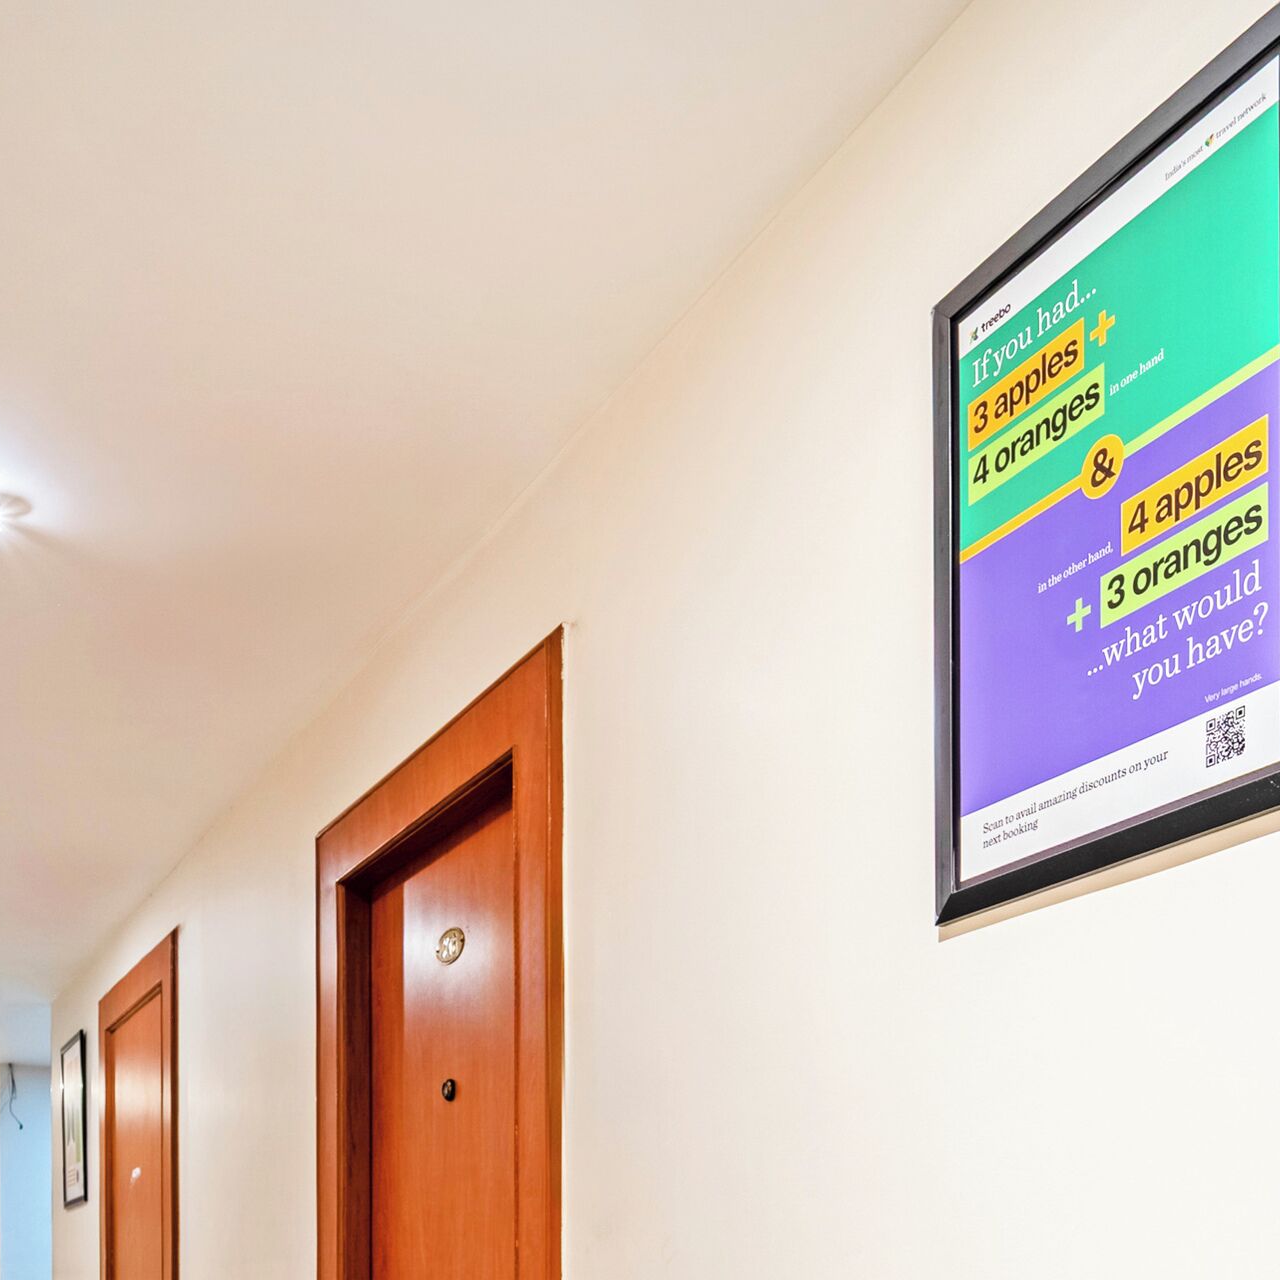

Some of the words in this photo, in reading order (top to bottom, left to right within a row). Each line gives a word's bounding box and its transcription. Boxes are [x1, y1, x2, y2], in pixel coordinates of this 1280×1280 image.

[972, 348, 993, 388] If
[992, 326, 1033, 377] you
[1036, 279, 1097, 338] had...
[981, 303, 1012, 333] treebo
[973, 400, 988, 434] 3
[994, 339, 1079, 417] apples
[1109, 383, 1120, 397] in
[1120, 370, 1139, 388] one
[1138, 347, 1164, 376] hand
[973, 453, 990, 485] 4
[994, 382, 1100, 473] oranges
[1090, 447, 1117, 488] &
[1127, 500, 1149, 534] 4
[1155, 439, 1263, 523] apples
[1037, 582, 1047, 594] in
[1047, 574, 1063, 588] the
[1063, 558, 1088, 580] other
[1107, 573, 1126, 610] 3
[1132, 504, 1263, 597] oranges
[1087, 614, 1169, 677] ...what
[1172, 559, 1262, 631] would
[1131, 653, 1182, 701] you
[1186, 601, 1269, 669] have?
[1204, 691, 1221, 703] Very
[1220, 683, 1239, 697] large
[982, 817, 1005, 834] Scan
[1005, 813, 1015, 825] to
[1015, 802, 1037, 820] avail
[1038, 787, 1078, 811] amazing
[1079, 768, 1127, 795] discounts
[1128, 762, 1144, 775] on
[1143, 750, 1169, 772] your
[982, 833, 1002, 849] next
[1003, 819, 1039, 841] booking
